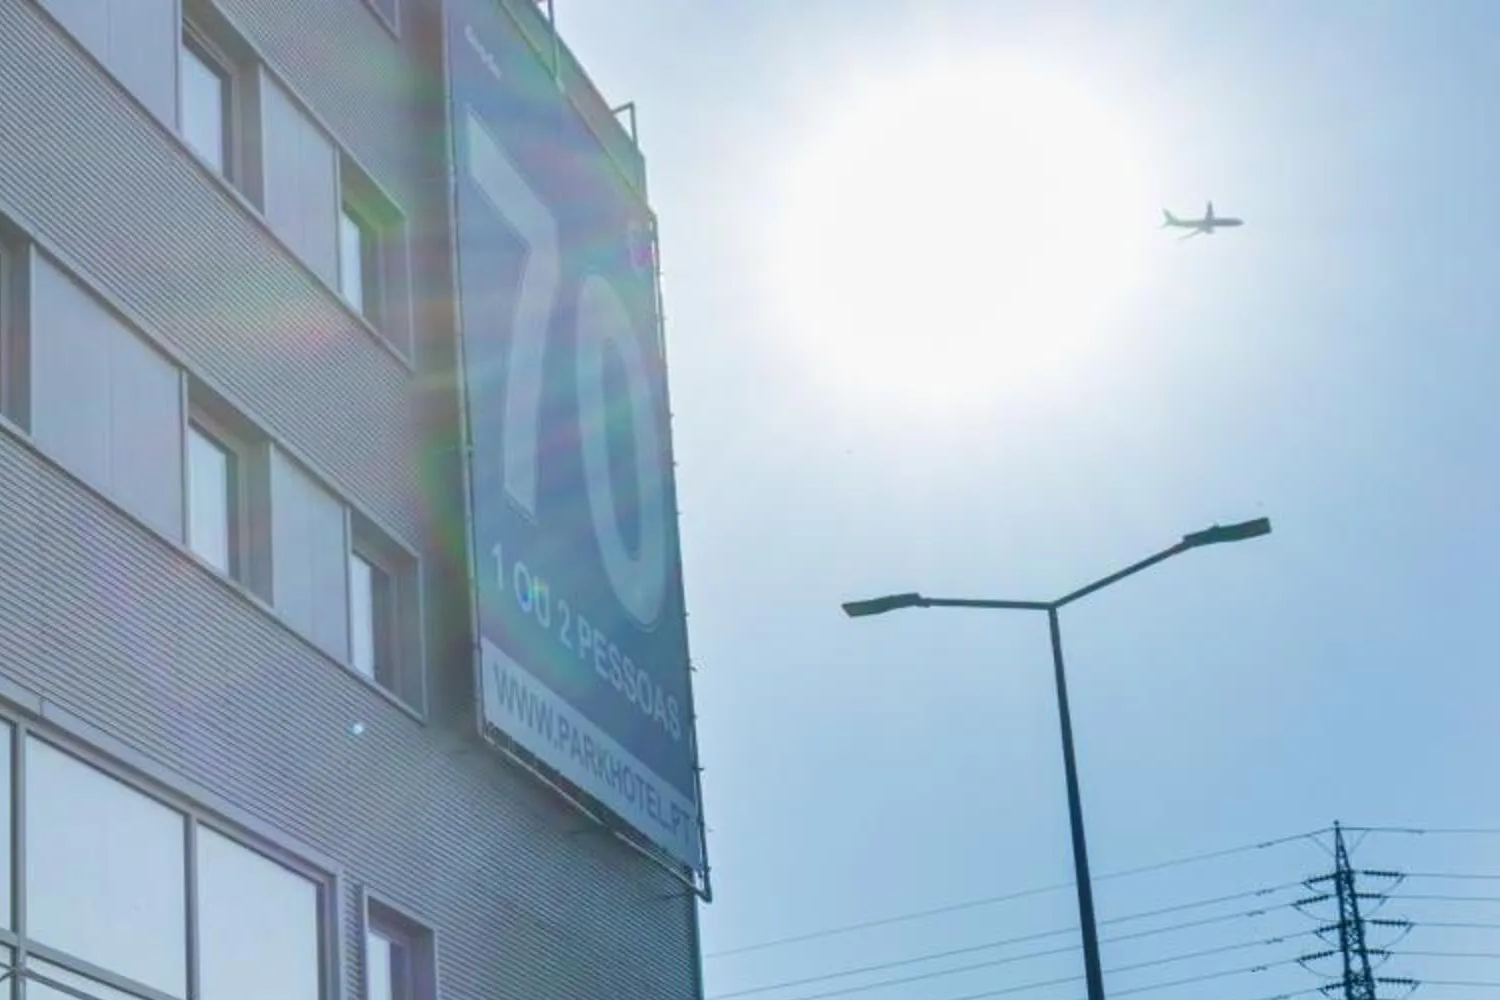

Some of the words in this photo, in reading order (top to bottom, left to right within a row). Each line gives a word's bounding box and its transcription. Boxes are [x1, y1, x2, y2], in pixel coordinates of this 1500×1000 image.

[490, 542, 503, 590] 1
[513, 561, 550, 628] OU
[557, 599, 573, 649] 2
[577, 612, 681, 741] PESSOAS
